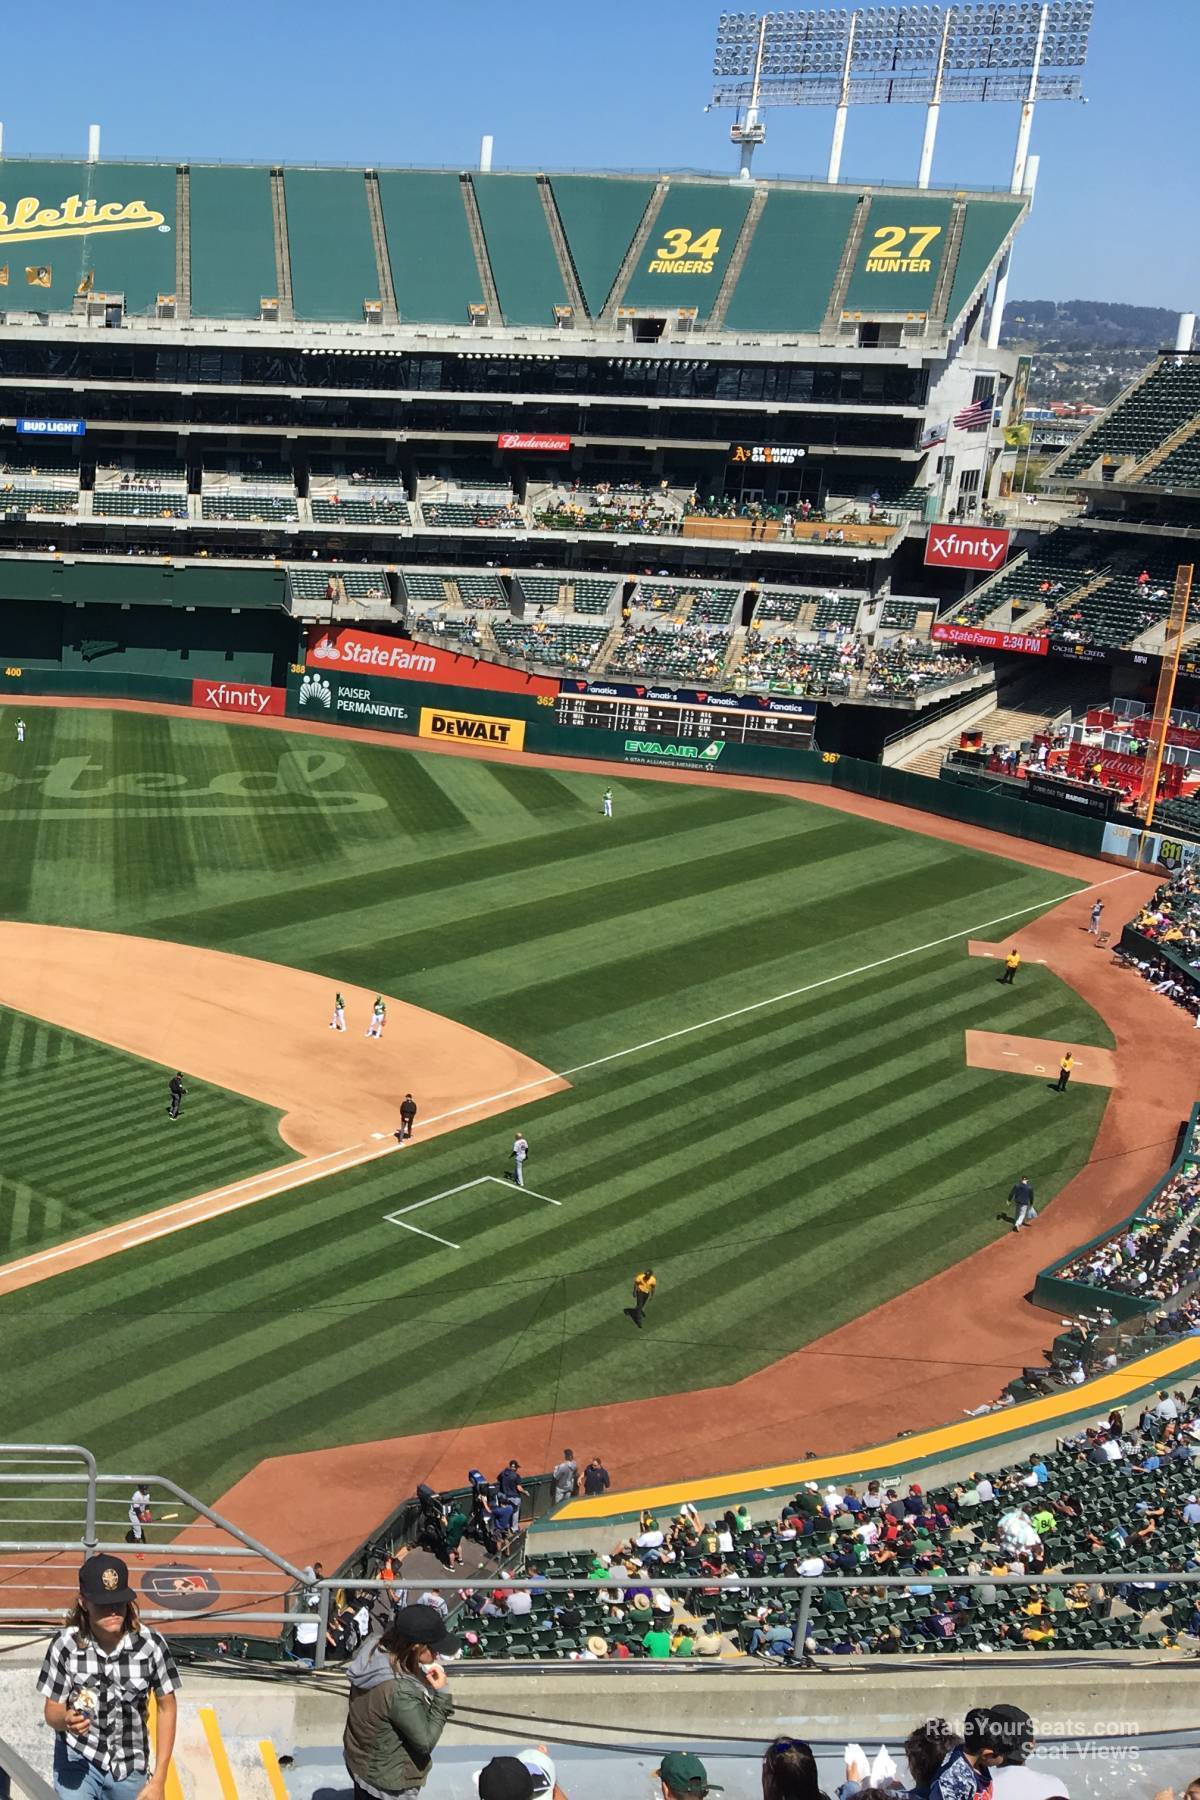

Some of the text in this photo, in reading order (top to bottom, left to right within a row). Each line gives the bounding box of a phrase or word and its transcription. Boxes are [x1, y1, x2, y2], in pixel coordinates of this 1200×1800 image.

[657, 228, 722, 259] 34
[869, 226, 942, 258] 27
[648, 260, 714, 273] FINGERS
[865, 259, 931, 272] HUNTER
[23, 421, 79, 433] BUD LIGHT
[502, 434, 567, 448] Budweiser
[932, 534, 1004, 561] xfinity
[1002, 635, 1040, 651] 2:34 PM
[5, 667, 22, 677] 400
[290, 664, 306, 674] 388
[206, 684, 271, 712] xfinity
[338, 686, 371, 700] KAISER
[646, 690, 677, 700] Fanatics
[537, 695, 555, 707] 362
[769, 702, 803, 712] Fanatics
[625, 740, 698, 758] EVA AIR
[822, 752, 840, 763] 367
[1161, 840, 1182, 861] 811
